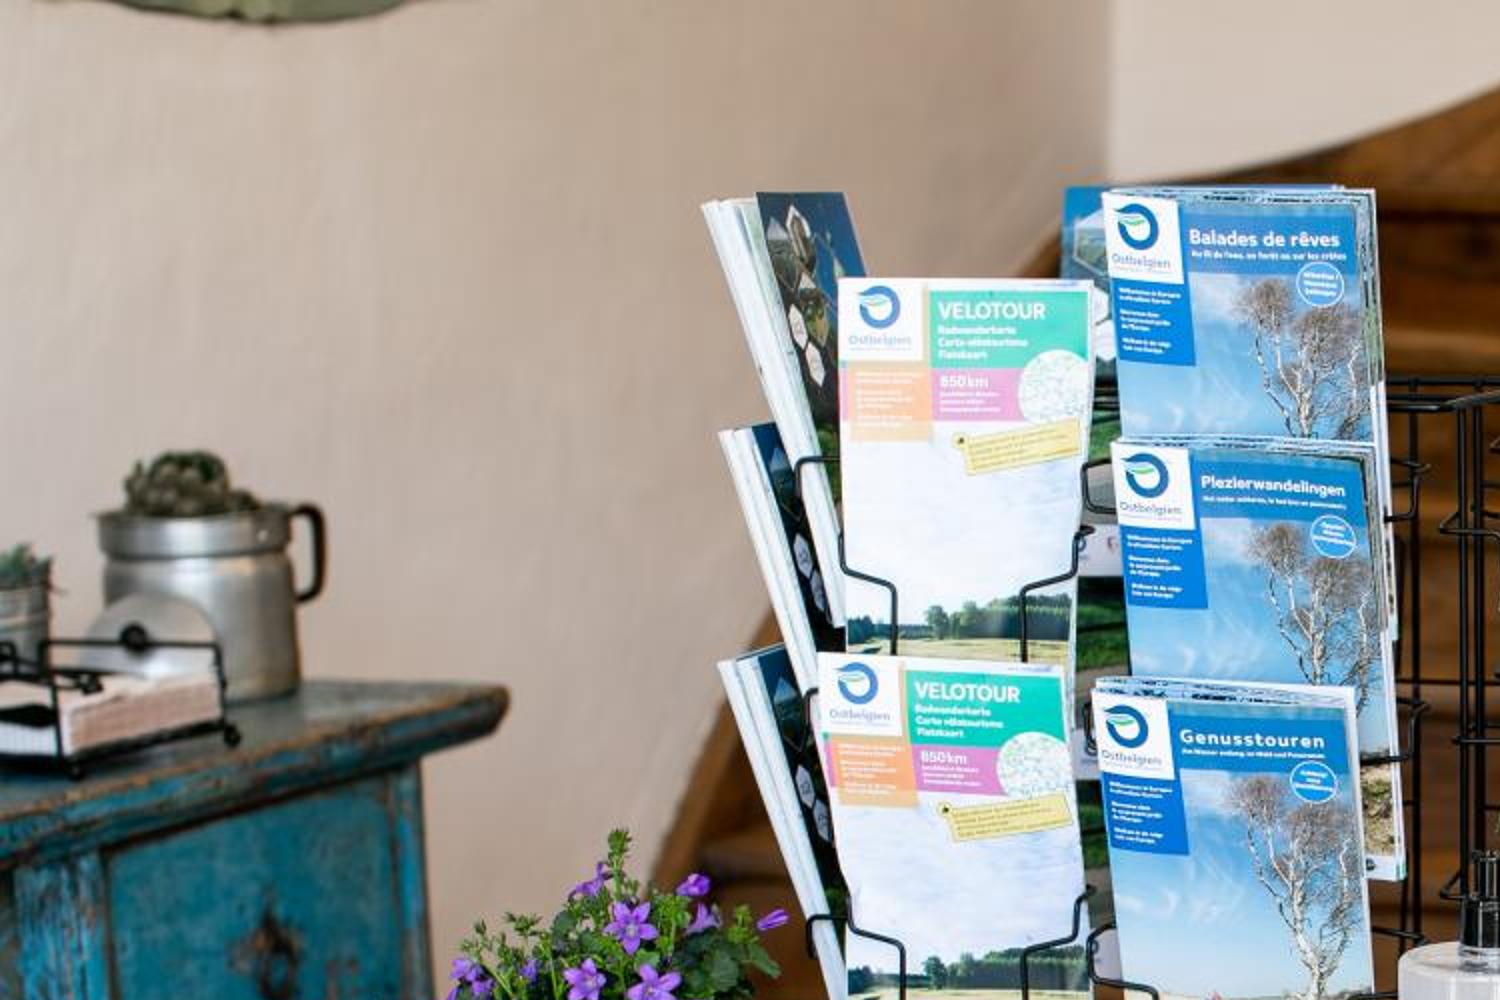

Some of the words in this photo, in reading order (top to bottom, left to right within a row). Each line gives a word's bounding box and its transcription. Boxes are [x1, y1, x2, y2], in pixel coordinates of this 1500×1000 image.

[1189, 229, 1258, 247] Balades
[1263, 230, 1285, 247] de
[1290, 232, 1340, 248] rêves
[1111, 253, 1171, 269] Ostbelgien
[938, 301, 1046, 321] VELOTOUR
[1200, 475, 1346, 498] Plezierwandelingen
[913, 681, 1021, 704] VELOTOUR
[1179, 728, 1325, 748] Genusstouren
